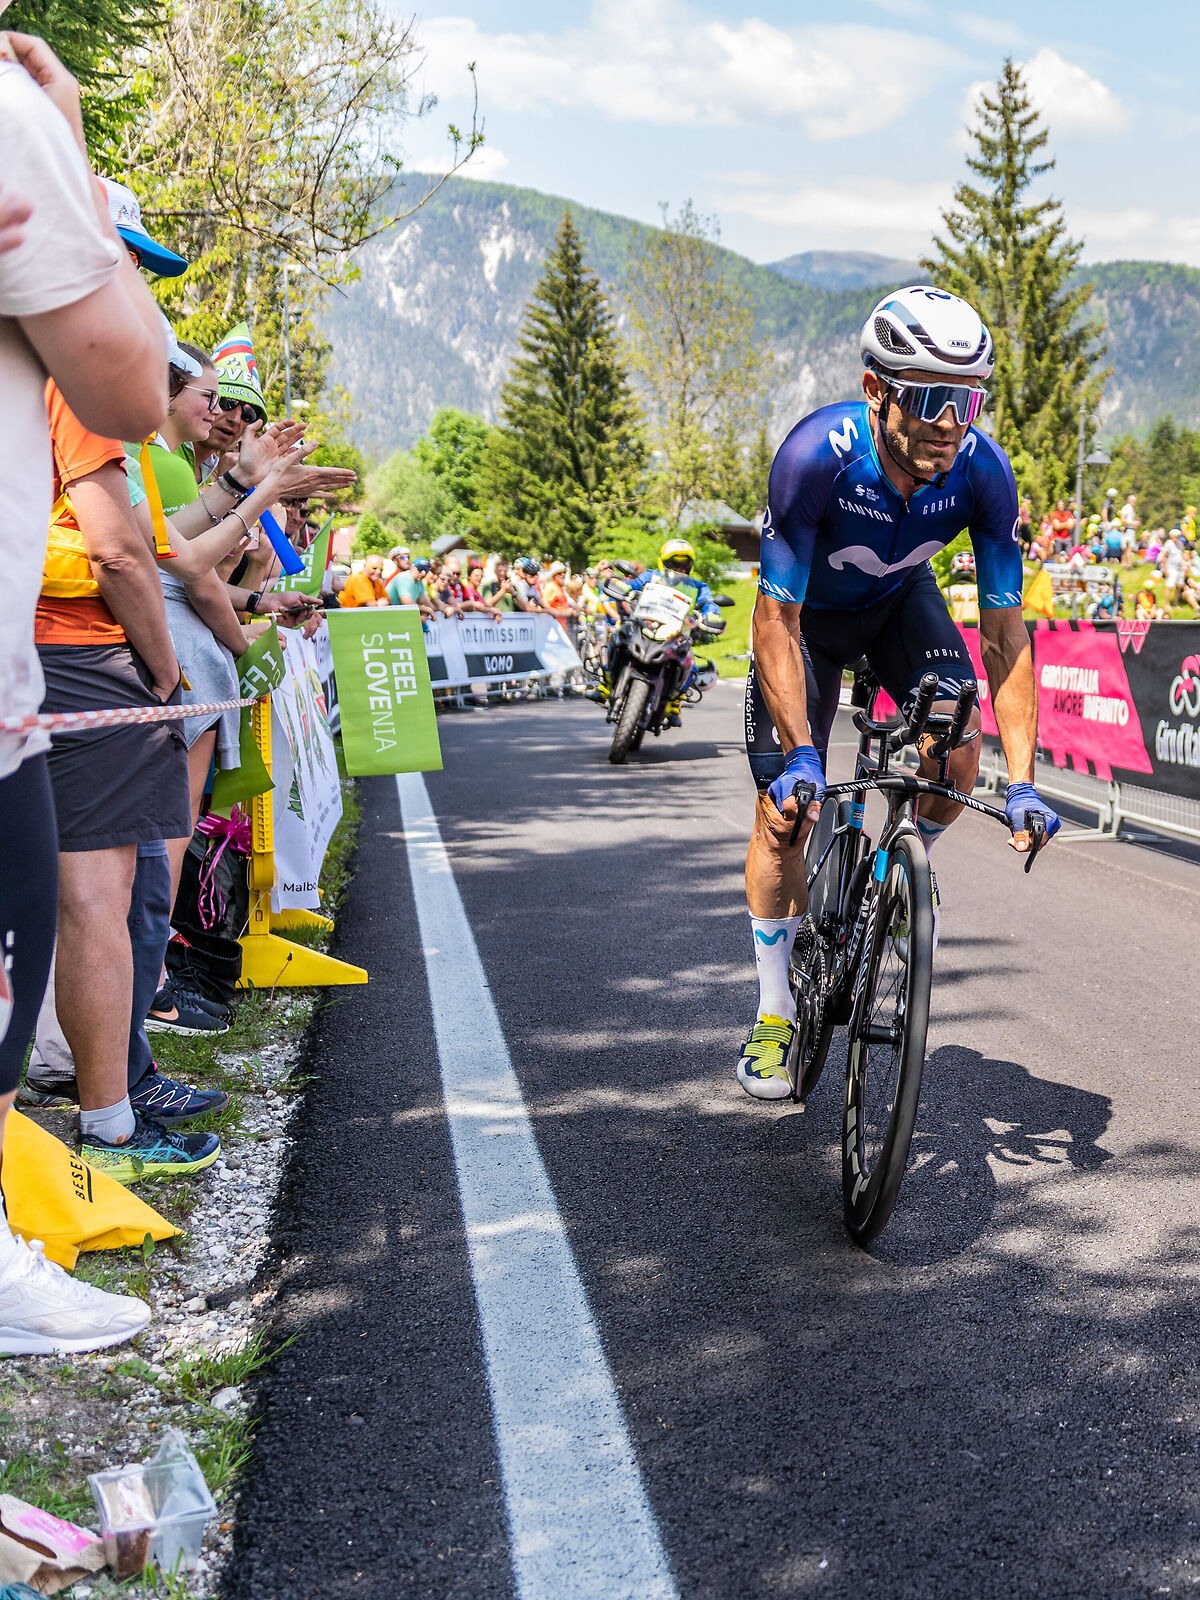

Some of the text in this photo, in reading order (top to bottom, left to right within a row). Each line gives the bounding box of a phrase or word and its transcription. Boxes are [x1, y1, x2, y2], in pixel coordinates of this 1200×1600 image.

[838, 498, 893, 522] CANYON
[922, 495, 956, 515] GOBIK
[484, 655, 513, 673] UOMO
[925, 648, 960, 658] GOBIK
[387, 632, 418, 704] I FEEL
[1041, 664, 1062, 690] GIRO
[361, 633, 397, 753] SLOVENIA
[745, 668, 756, 742] Telefónica
[1053, 691, 1129, 726] AMORE INFINITO
[837, 781, 878, 793] CANYON
[947, 789, 986, 812] CANYON
